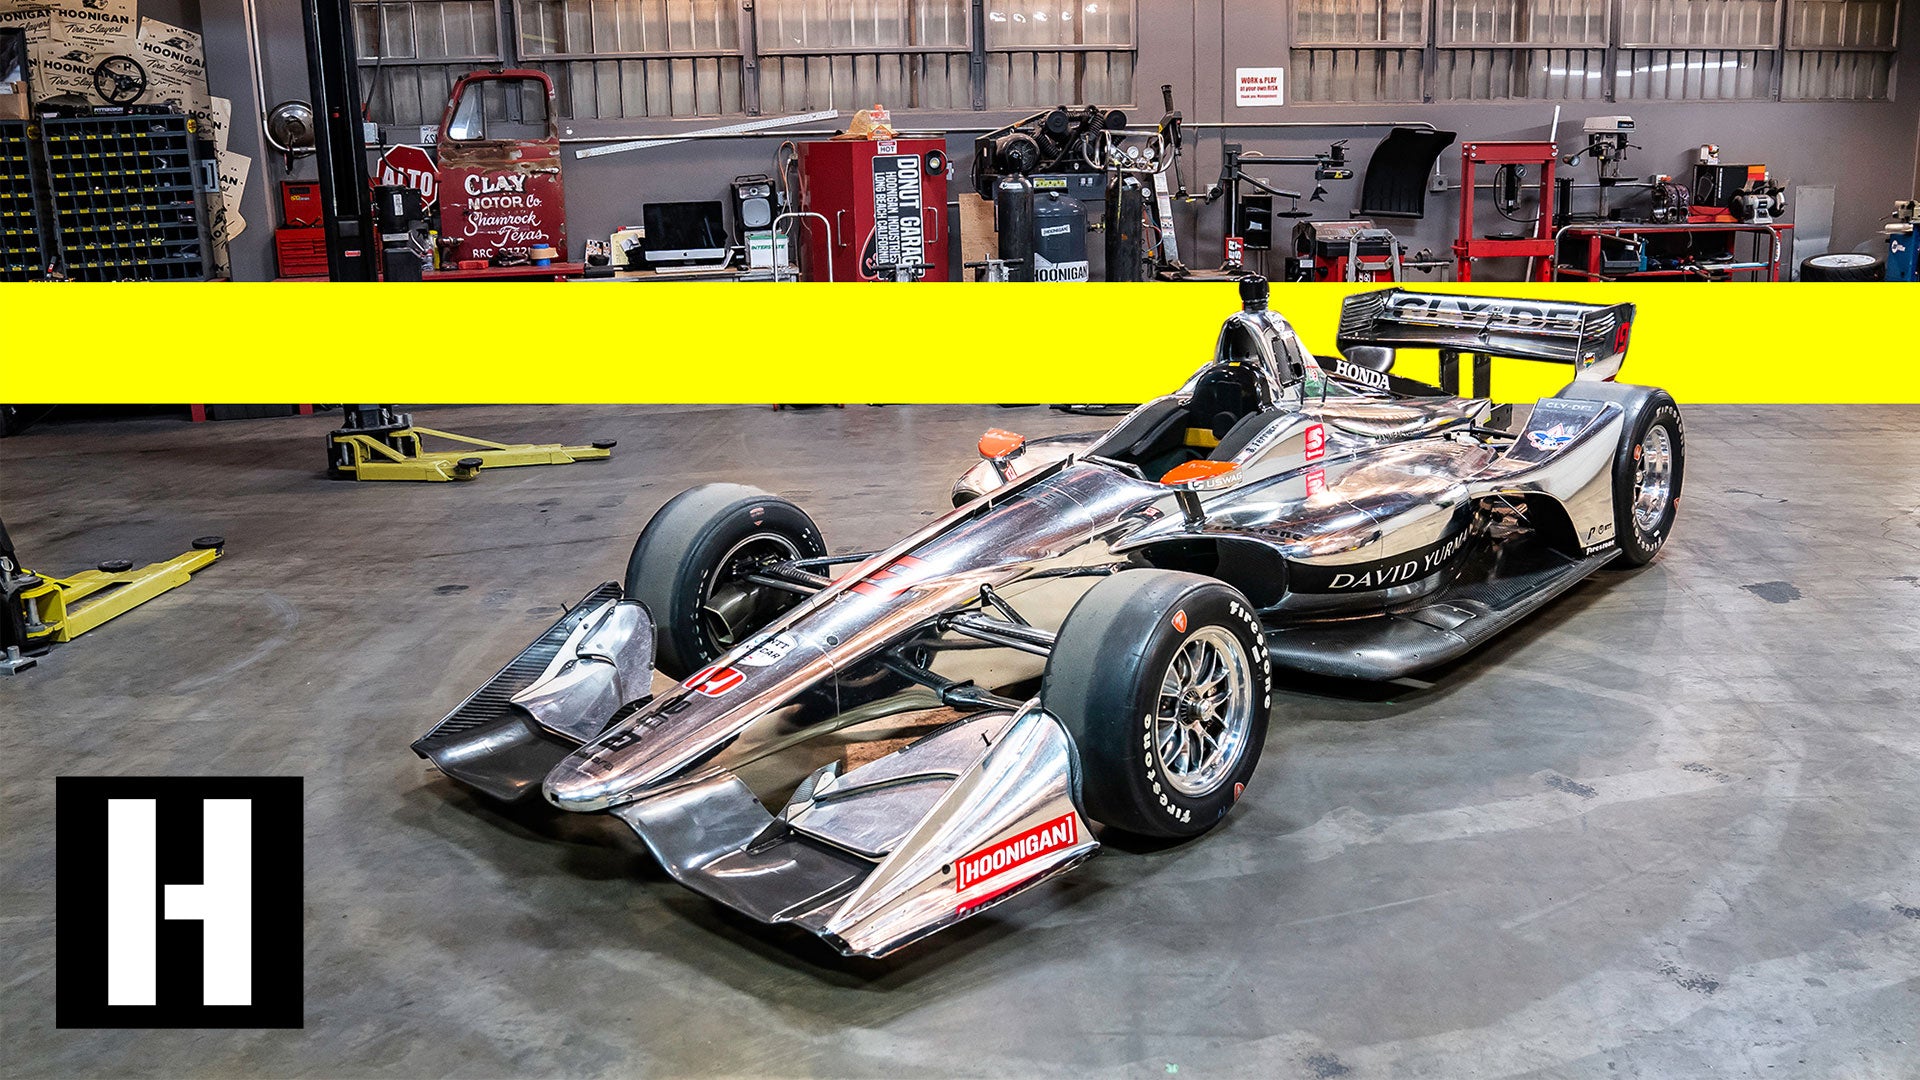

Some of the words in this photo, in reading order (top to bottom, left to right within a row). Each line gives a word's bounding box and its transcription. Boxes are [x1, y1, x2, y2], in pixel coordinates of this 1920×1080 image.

[58, 9, 129, 24] HOONIGAN
[64, 24, 85, 34] Tire
[86, 23, 123, 36] Slayers
[146, 59, 165, 70] Tire
[1240, 76, 1258, 84] WORK
[1264, 76, 1278, 84] PLAY
[464, 174, 526, 196] CLAY
[874, 172, 886, 193] LONG
[885, 171, 899, 214] HOONIGAN
[896, 158, 920, 209] DONUT
[467, 196, 524, 210] MOTOR
[875, 194, 888, 219] BEACH
[464, 210, 542, 237] Shamrock
[490, 225, 549, 247] Texas
[876, 220, 889, 264] CALIFORNIA
[887, 216, 901, 264] INDUSTRIES
[472, 248, 494, 259] RRC
[1613, 321, 1631, 354] 19
[1335, 359, 1391, 391] HONDA
[1206, 471, 1243, 488] USWAG
[1328, 560, 1418, 589] DAVID
[1228, 600, 1272, 710] Firestone
[1143, 713, 1191, 824] Firestone
